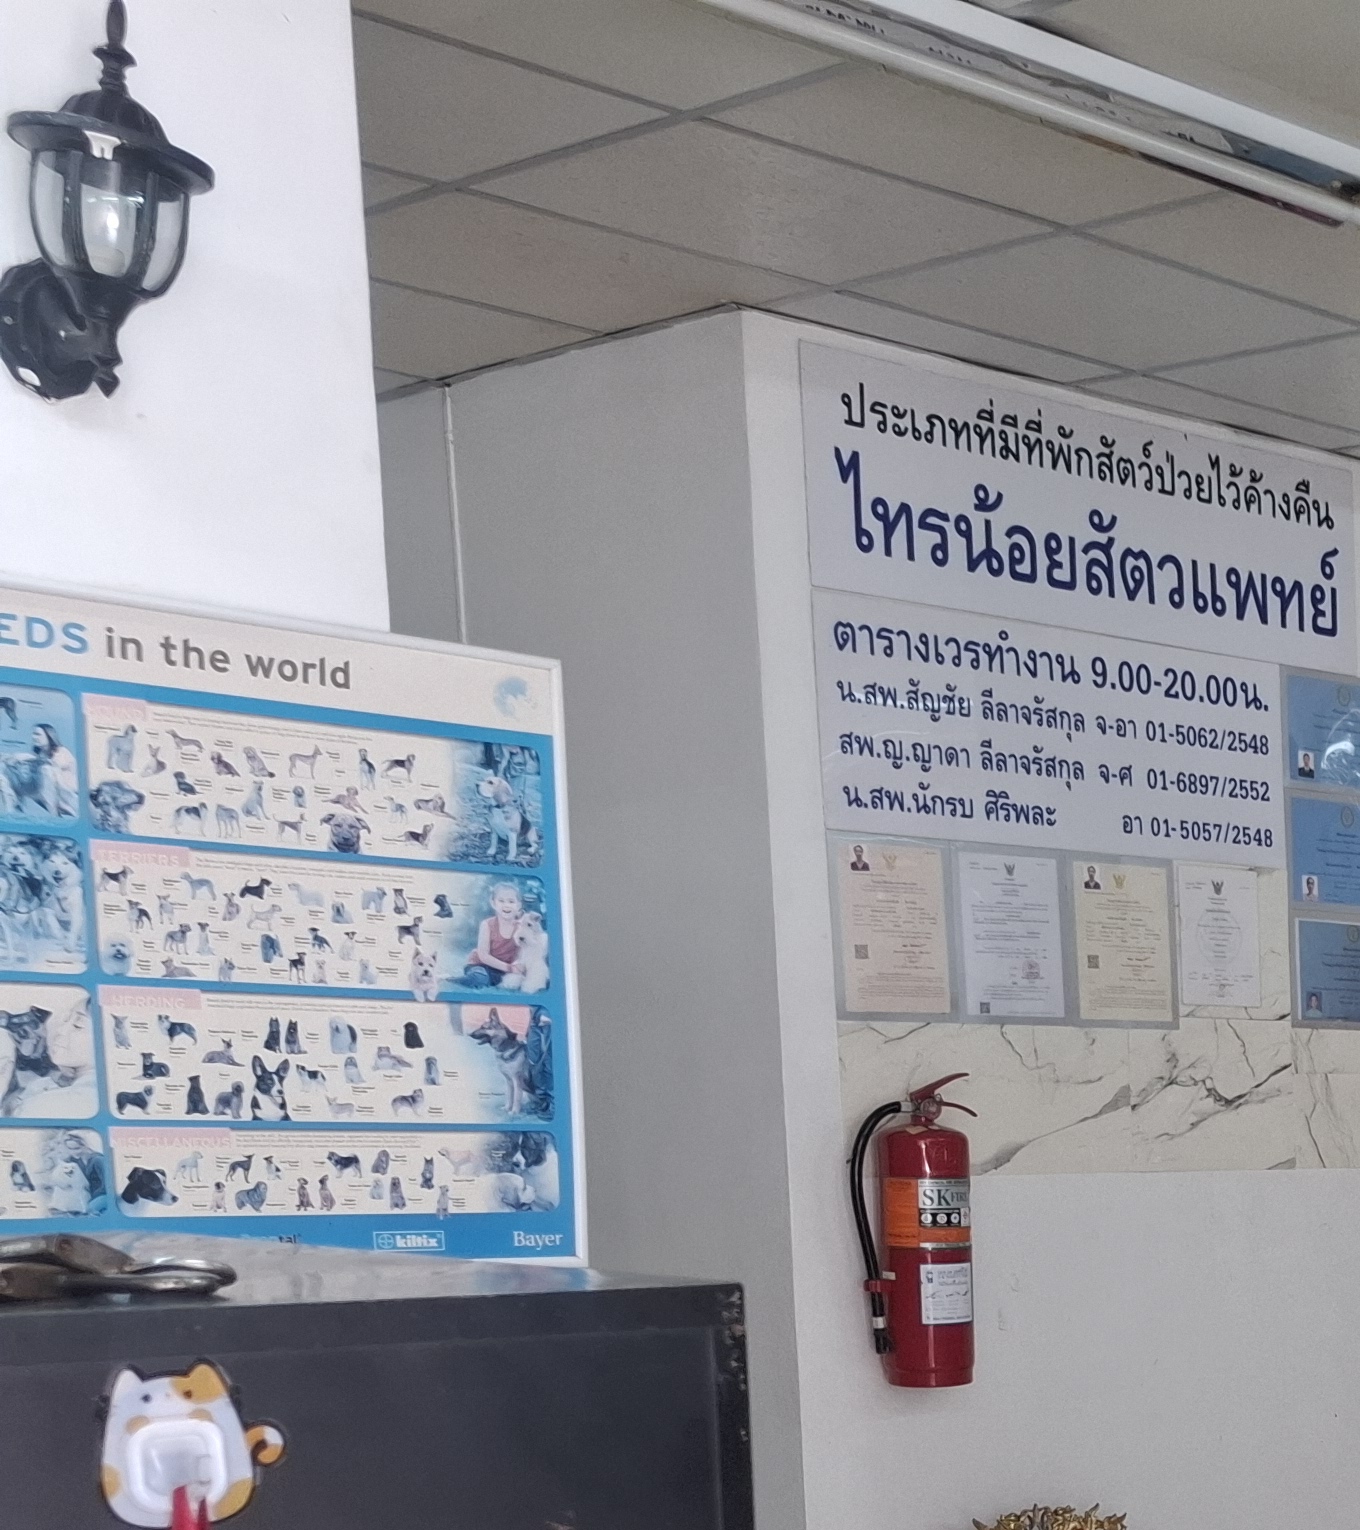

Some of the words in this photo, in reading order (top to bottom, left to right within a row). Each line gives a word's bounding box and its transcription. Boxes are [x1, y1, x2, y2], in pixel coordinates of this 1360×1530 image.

[841, 383, 1334, 530] ประเภทที่มีที่พักสัตว์ป่วยไว้ค้างคืน
[834, 446, 1338, 637] ไทรน้อยสัตวแพทย์
[105, 627, 144, 662] in
[160, 636, 231, 673] the
[245, 652, 351, 690] world
[834, 620, 1081, 686] ตารางเวรทำงาน
[1090, 656, 1270, 713] 9.00-20.00น.
[837, 677, 971, 722] น.สพ.สัญชัย
[980, 689, 1085, 742] ลีลาจรัสกุล
[1095, 714, 1138, 741] จ-อา
[1145, 722, 1270, 756] 01-5062/2548
[839, 730, 971, 774] สพ.ญ.ญาดา
[980, 740, 1085, 791] ลีลาจรัสกุล
[1098, 763, 1133, 787] จ-ศ
[1147, 767, 1270, 802] 01-6897/2552
[842, 781, 974, 819] น.สพ.นักรบ
[1122, 813, 1144, 837] อา
[1150, 816, 1274, 848] 01-5057/2548
[923, 1189, 951, 1206] SK
[513, 1231, 563, 1250] Bayer
